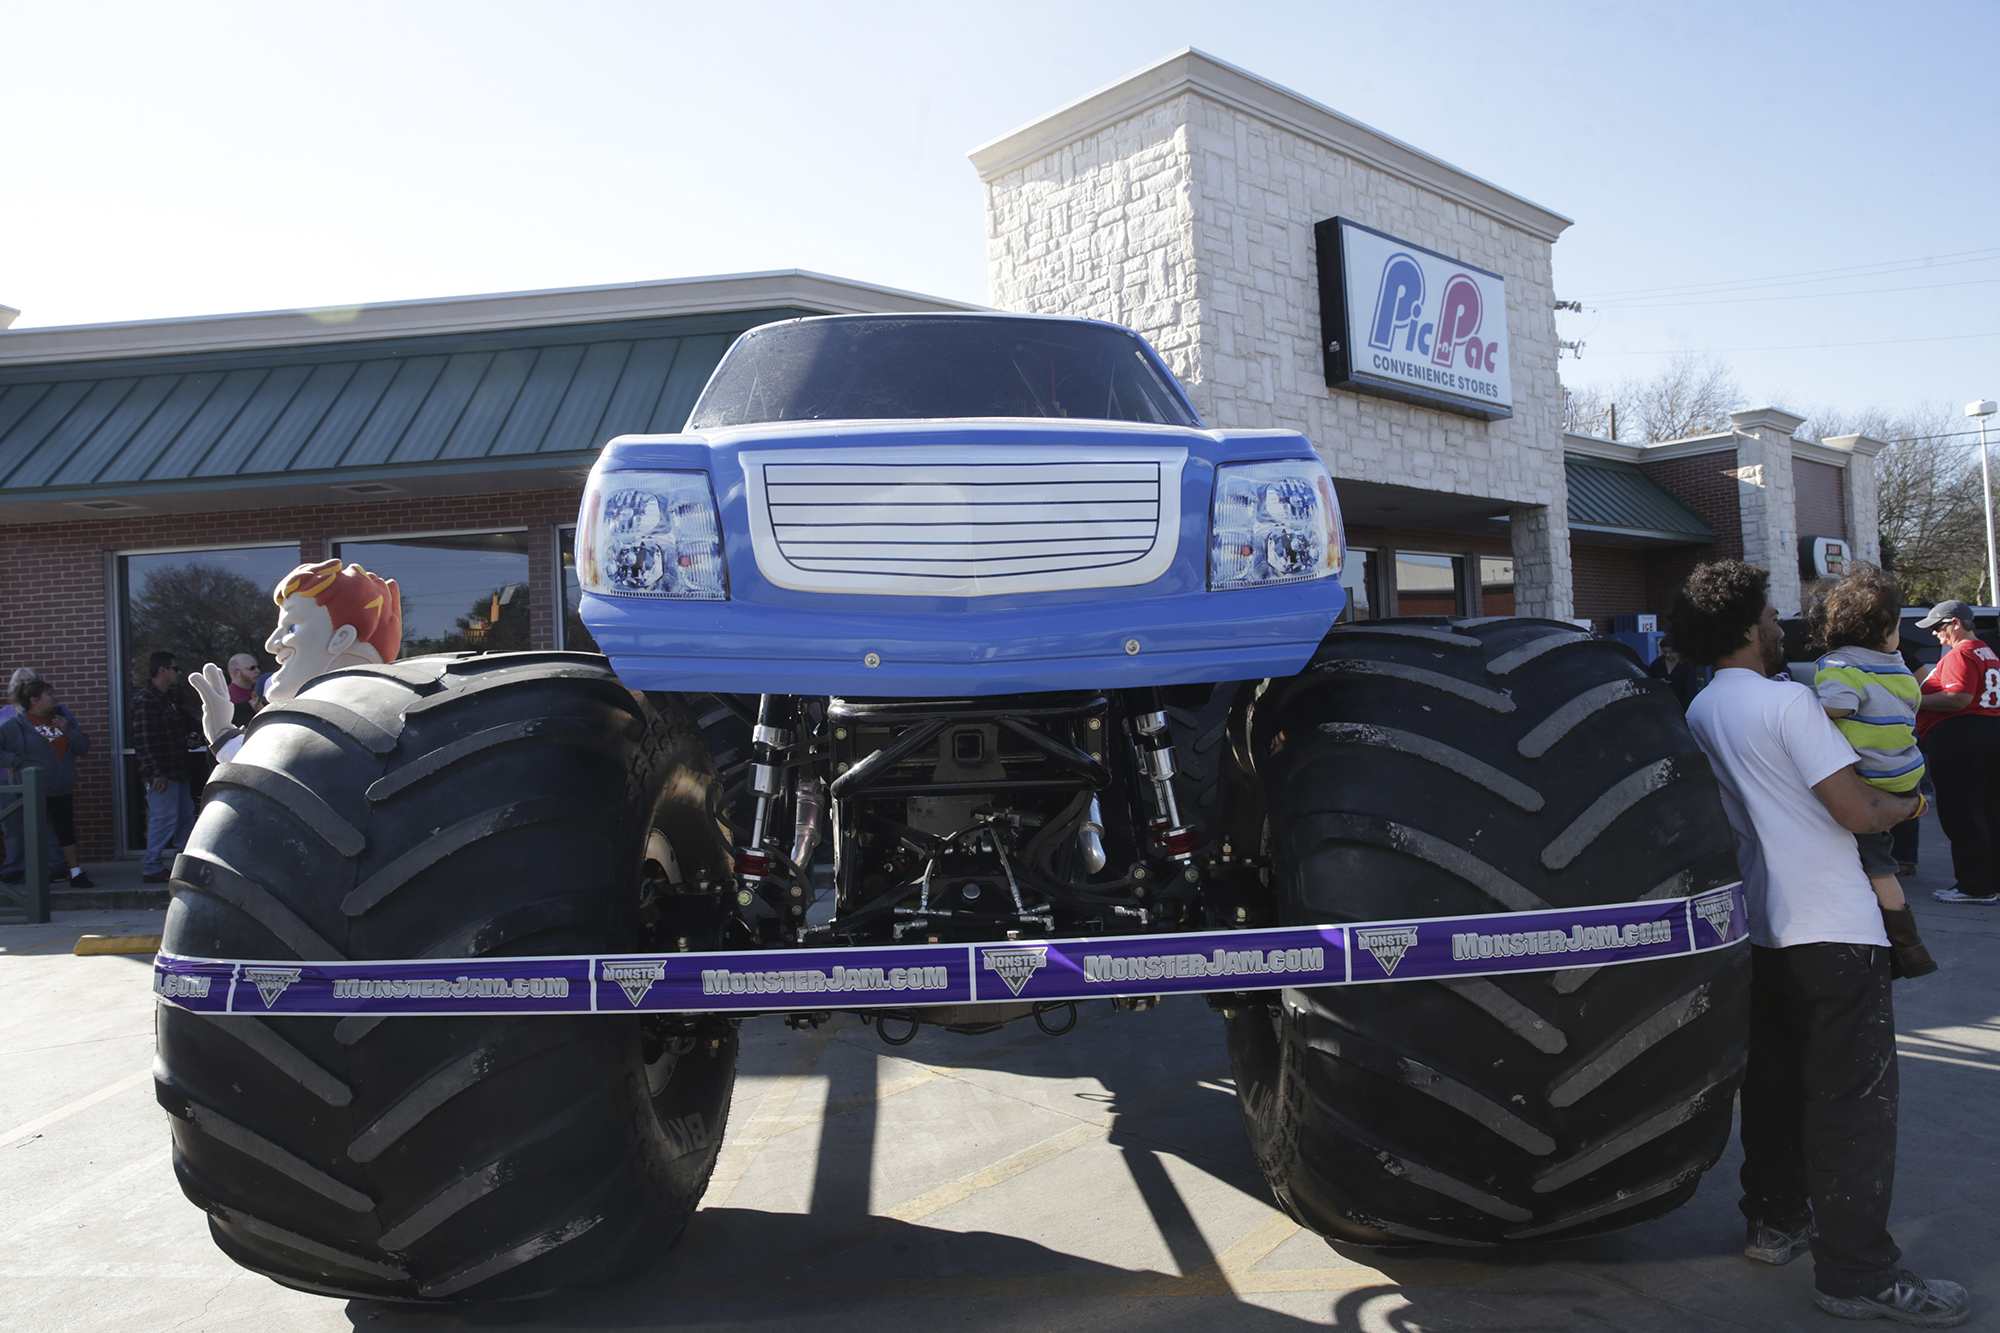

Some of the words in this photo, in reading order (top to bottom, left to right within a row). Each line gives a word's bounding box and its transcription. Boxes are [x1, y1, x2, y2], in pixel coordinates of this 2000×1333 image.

[1368, 252, 1434, 356] Pic
[1431, 273, 1498, 373] Pac
[1373, 354, 1455, 388] CONVENIENCE
[1458, 376, 1498, 398] STORES
[1642, 622, 1653, 632] ICE
[1358, 934, 1417, 949] MONSTER
[1373, 946, 1403, 957] JAM
[984, 955, 1046, 969] MONSTER
[603, 967, 665, 981] MONSTER
[1000, 967, 1030, 977] JAM
[620, 979, 649, 988] JAM
